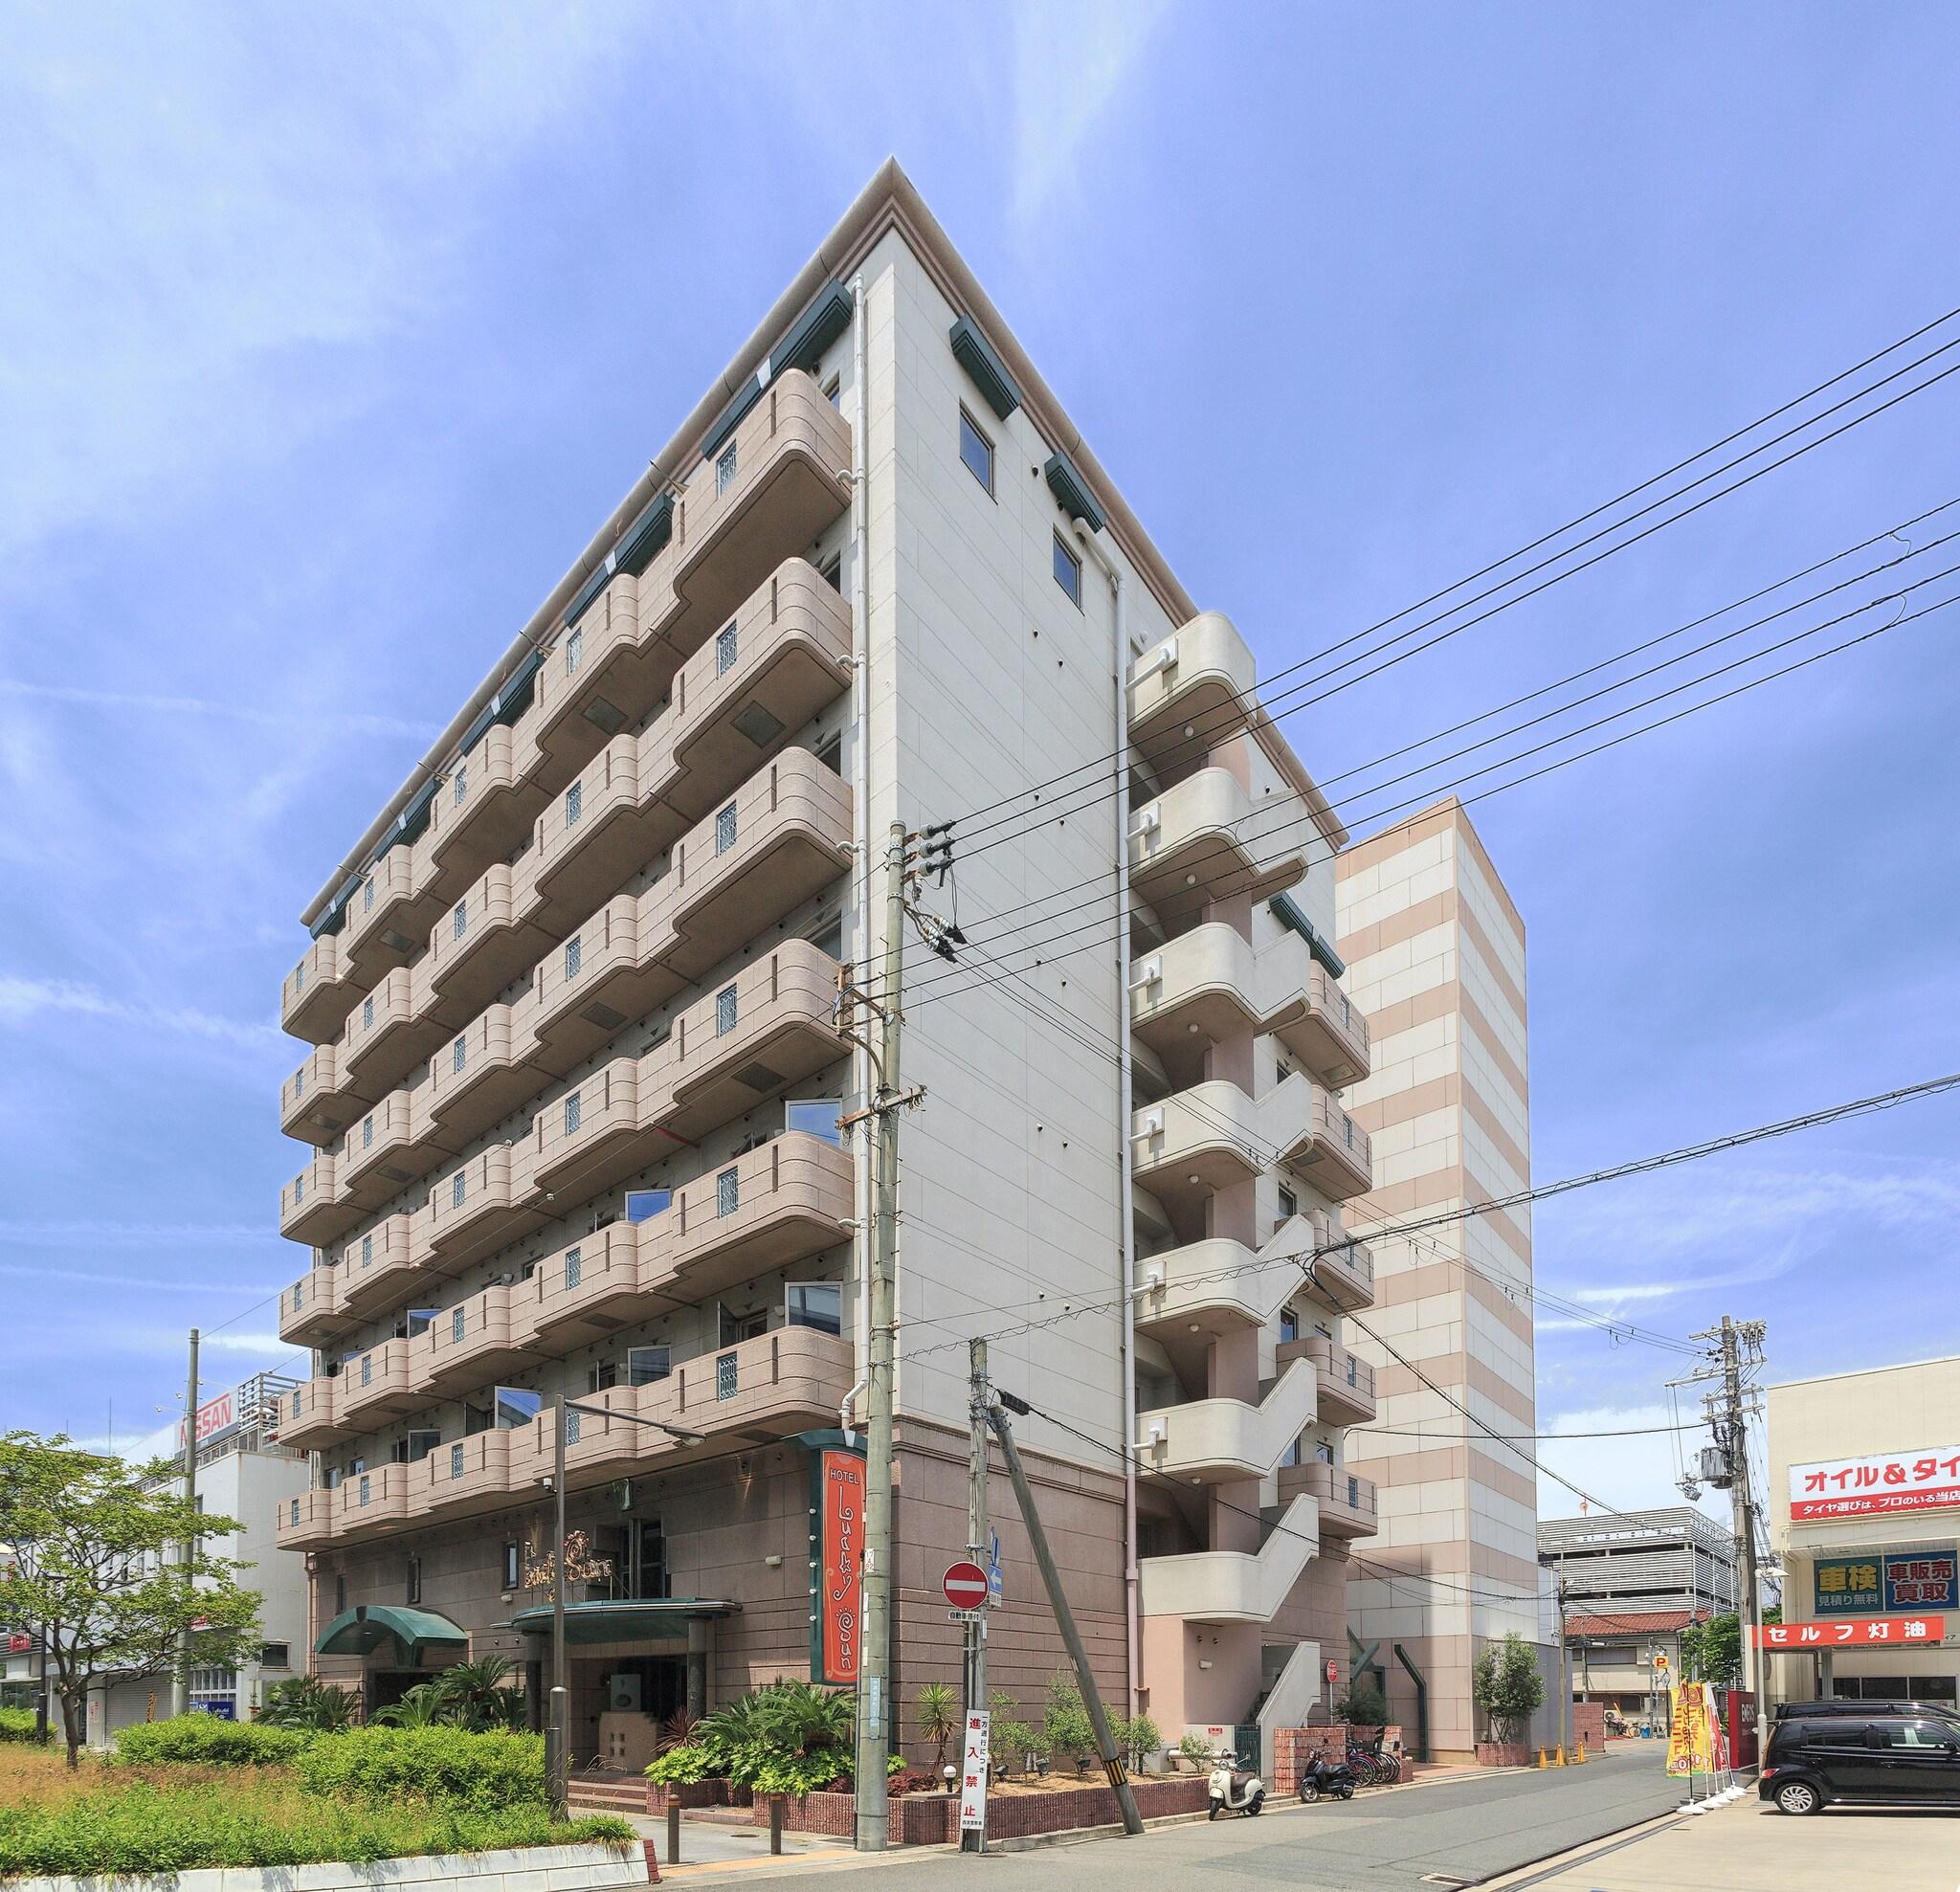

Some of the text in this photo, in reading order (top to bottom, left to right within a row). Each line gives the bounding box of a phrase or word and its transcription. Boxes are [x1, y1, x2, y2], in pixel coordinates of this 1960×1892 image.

[180, 1398, 231, 1449] NSSAN
[830, 1468, 859, 1484] HOTEL
[833, 1484, 856, 1669] Lucky Sun
[1819, 1565, 1877, 1592] 車検
[1888, 1560, 1952, 1581] 車販売
[1818, 1592, 1879, 1607] 見積り無料
[1894, 1582, 1949, 1603] 買取
[1769, 1621, 1927, 1642] セルフ灯油
[964, 1718, 981, 1816] 進入禁止
